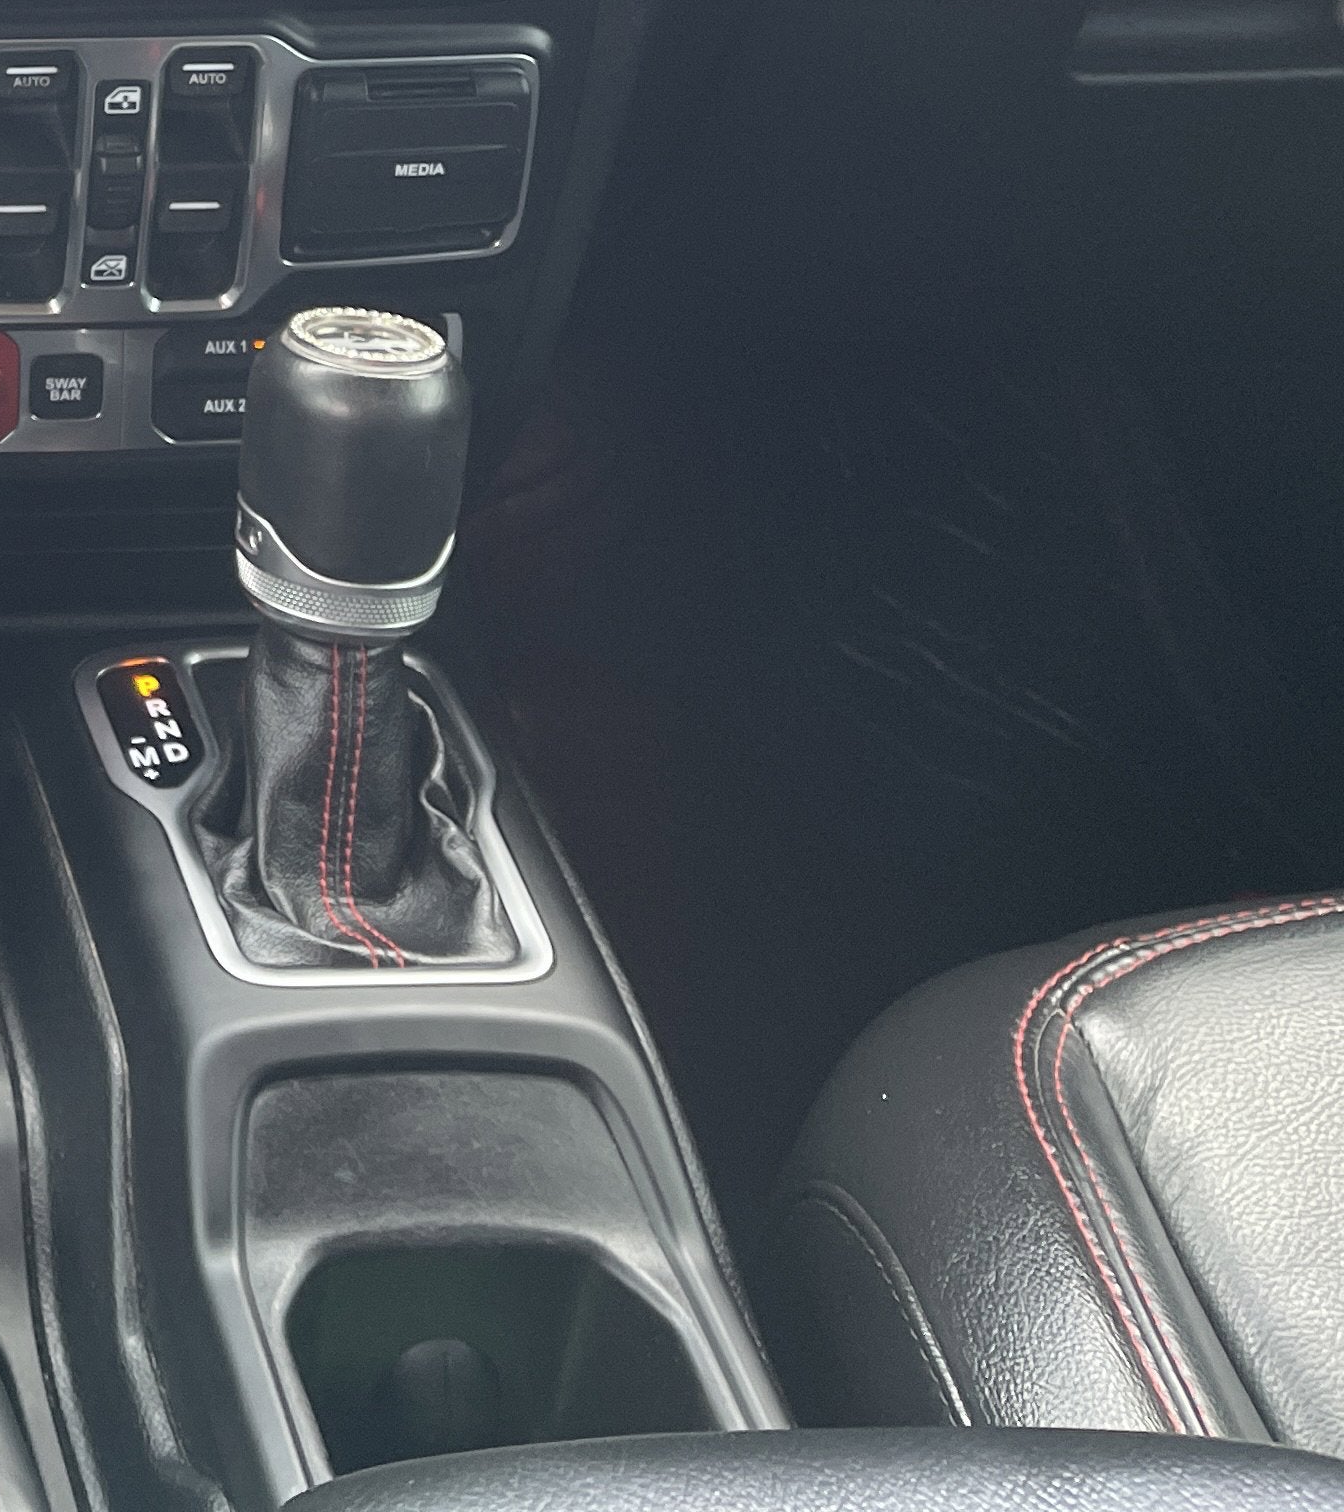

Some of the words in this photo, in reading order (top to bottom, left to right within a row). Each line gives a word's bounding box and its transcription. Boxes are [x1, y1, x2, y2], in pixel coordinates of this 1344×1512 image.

[12, 76, 51, 88] AUTO
[188, 73, 228, 86] AUTO
[394, 163, 446, 178] MEDIA
[204, 340, 238, 354] AUX
[241, 340, 248, 353] 1
[44, 377, 87, 392] SWAY
[49, 389, 83, 402] BAR
[203, 399, 236, 414] AUX
[238, 399, 246, 412] 2
[131, 674, 160, 697] P
[145, 698, 171, 718] R
[154, 719, 182, 740] N
[128, 746, 160, 768] M
[163, 742, 189, 763] D
